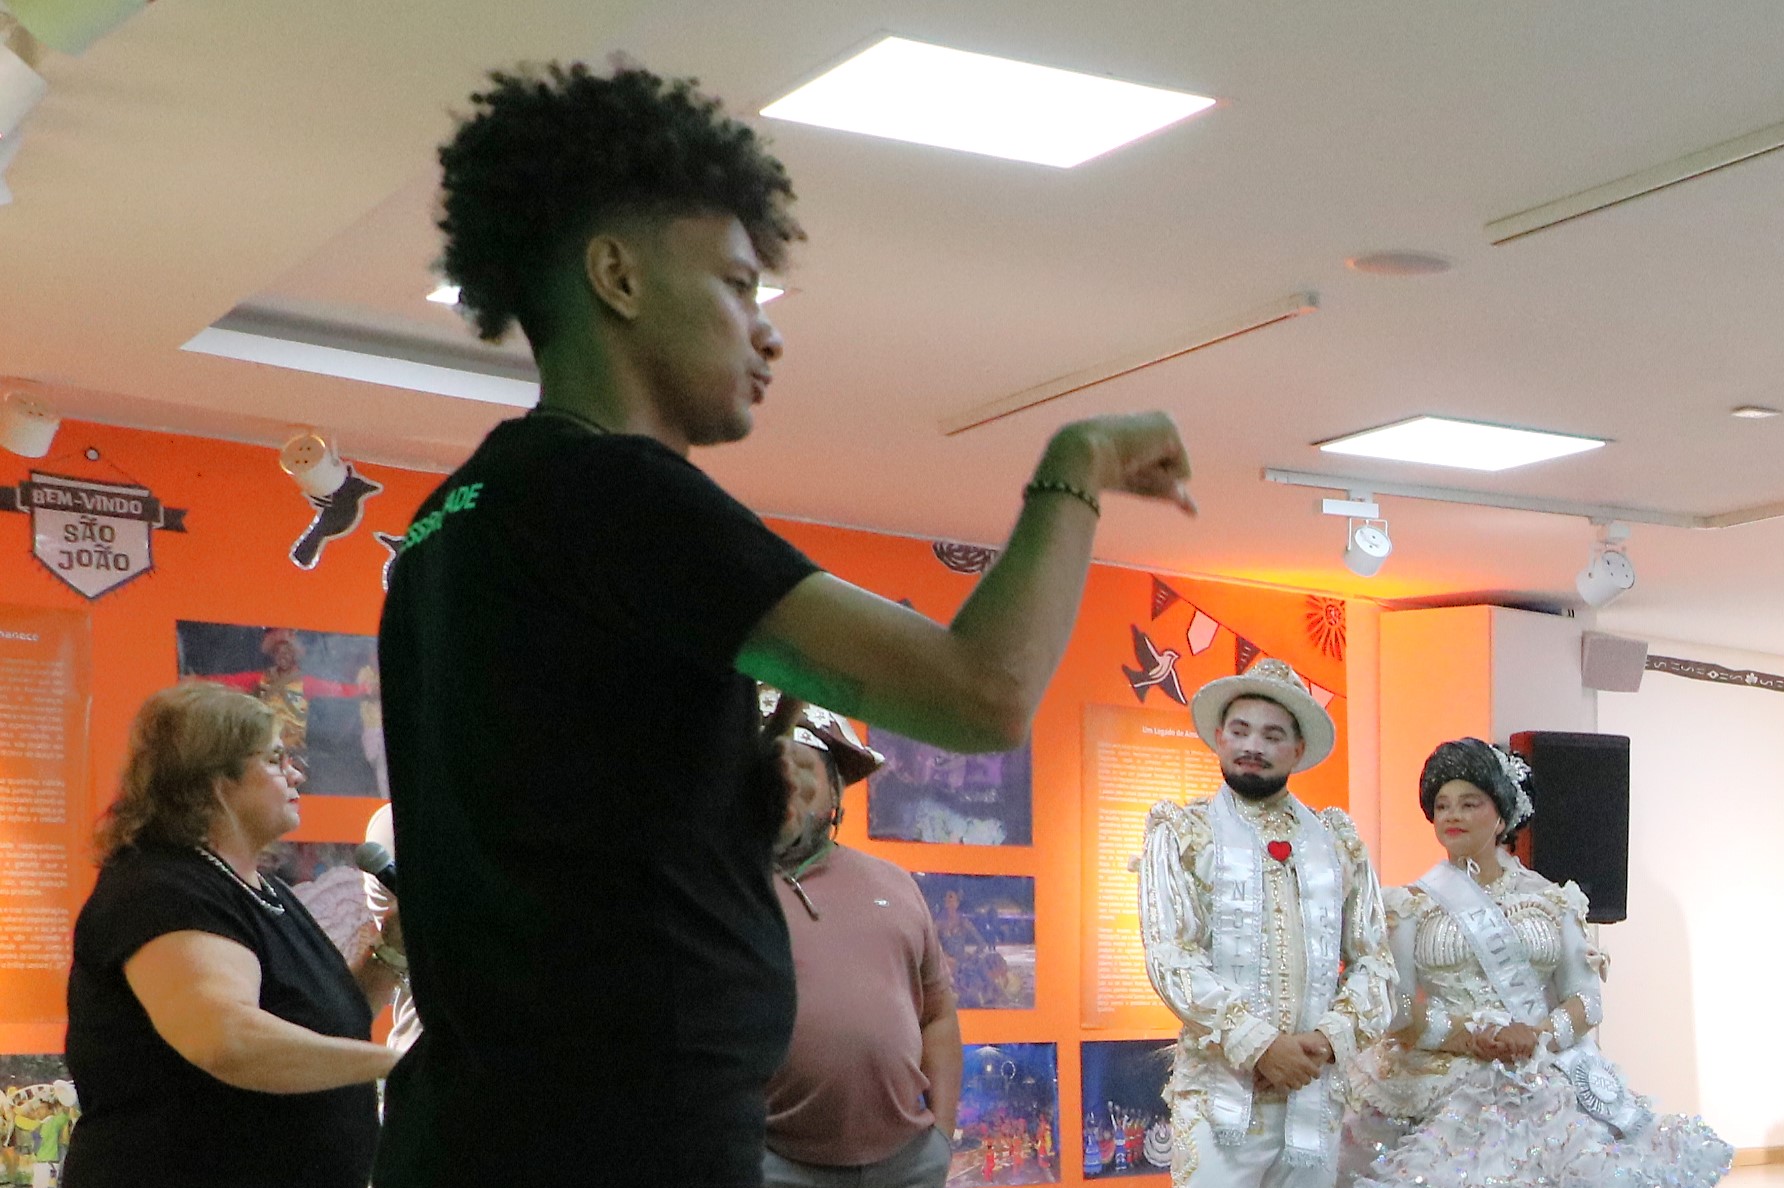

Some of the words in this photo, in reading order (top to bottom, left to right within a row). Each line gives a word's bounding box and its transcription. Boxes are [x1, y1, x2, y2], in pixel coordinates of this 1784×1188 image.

[32, 488, 143, 515] BEM-VINDO
[64, 514, 117, 543] SÃO
[58, 543, 130, 571] JOÃO
[1142, 725, 1153, 735] Um
[1154, 727, 1175, 738] Legado
[1176, 729, 1184, 737] de
[1184, 730, 1199, 739] Amo
[1230, 879, 1247, 985] NOIV
